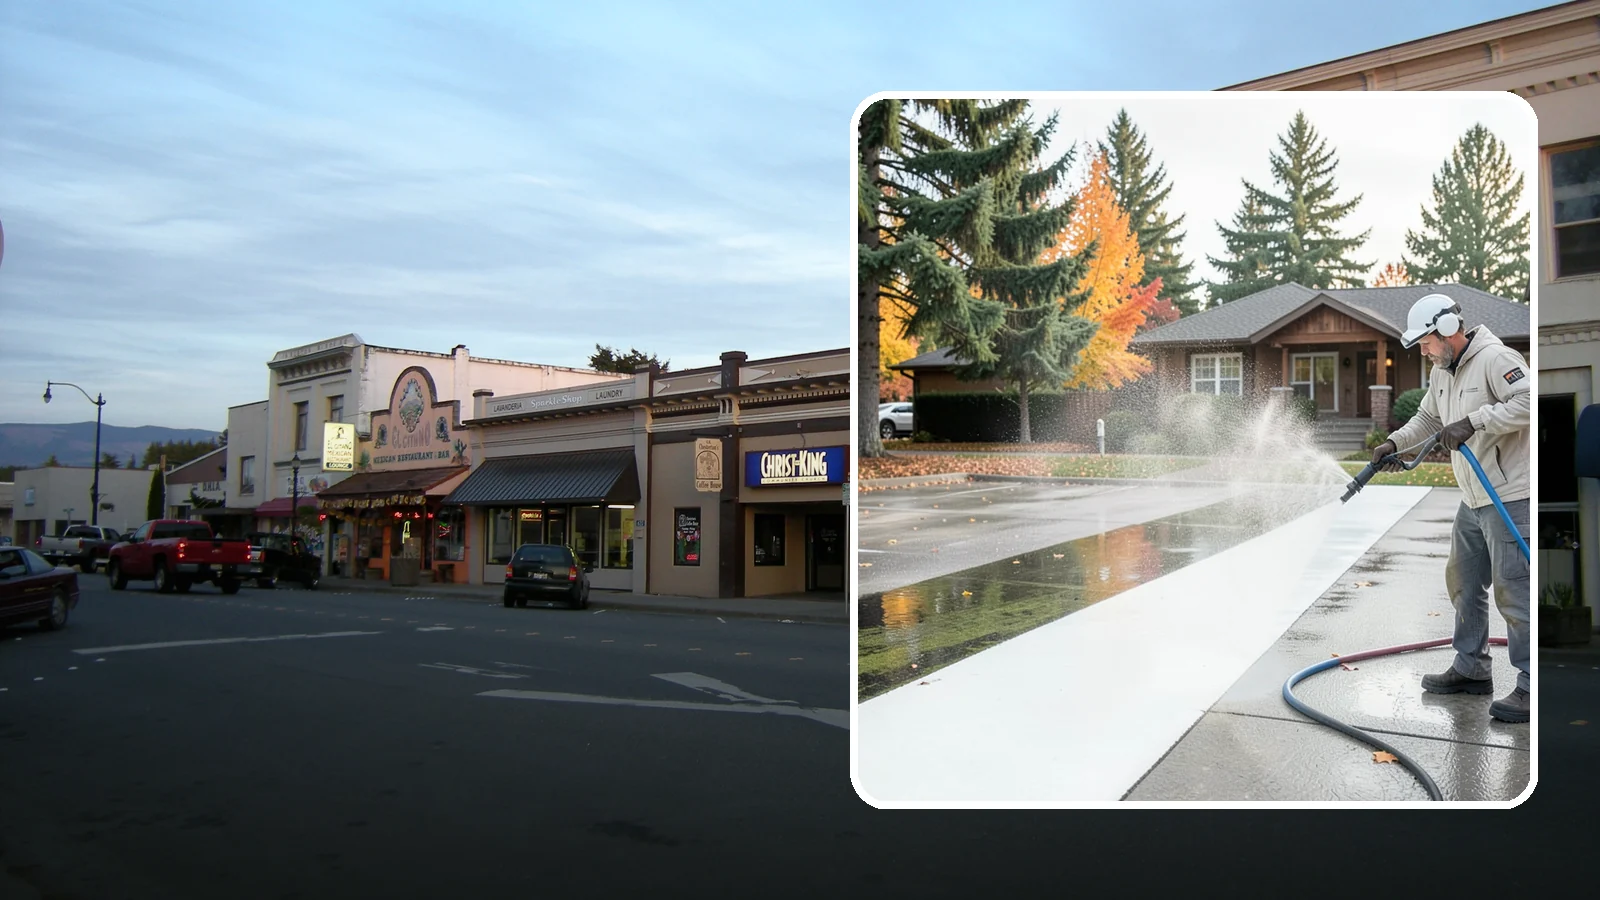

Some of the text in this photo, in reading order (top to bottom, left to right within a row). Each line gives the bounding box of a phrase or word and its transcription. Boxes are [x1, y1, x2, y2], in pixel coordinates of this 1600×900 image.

[494, 389, 623, 412] LAVANDERIA Sparkle Shop LAUNDRY
[373, 454, 396, 464] MEXICAN
[398, 451, 433, 462] RESTAURANT
[438, 450, 450, 459] BAR
[761, 450, 827, 478] CHRIST KING
[697, 480, 709, 489] Coffee
